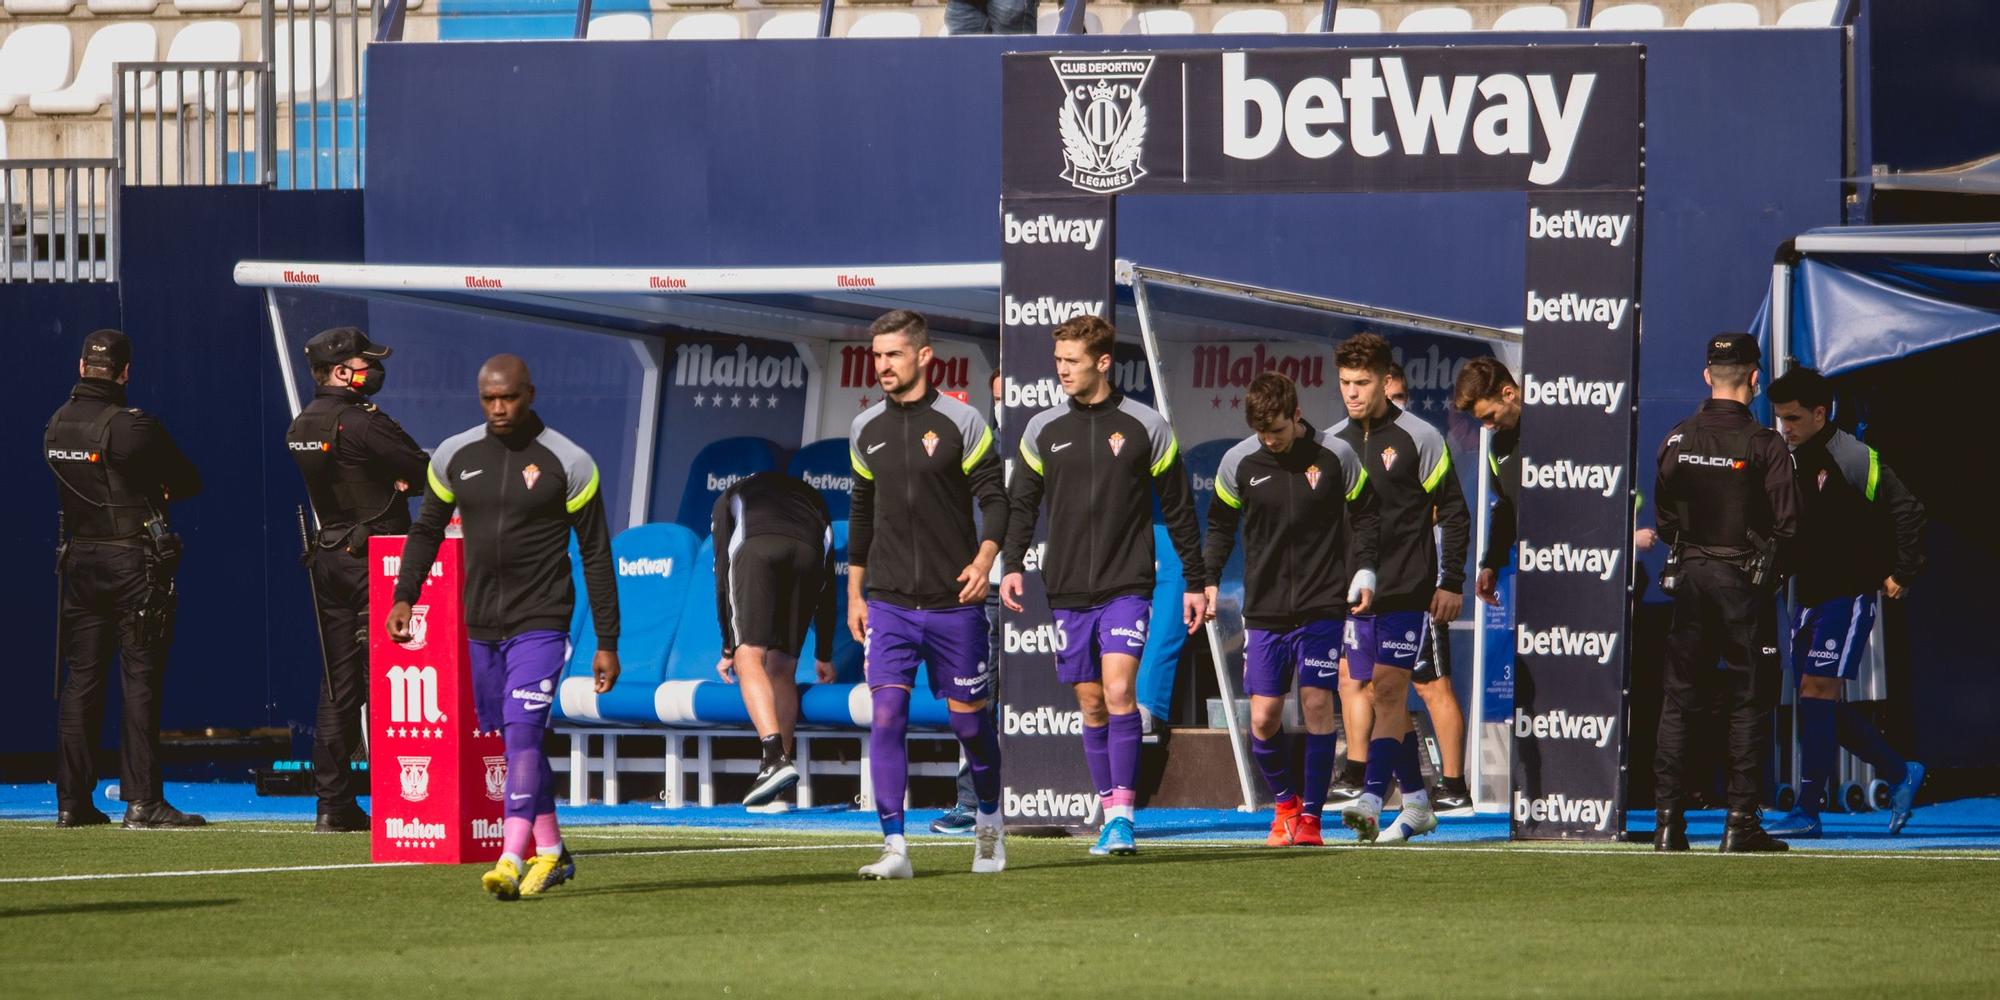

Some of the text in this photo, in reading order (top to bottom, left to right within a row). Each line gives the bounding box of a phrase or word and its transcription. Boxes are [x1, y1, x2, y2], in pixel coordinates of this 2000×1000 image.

[1060, 62, 1145, 74] CLUB DEPORTIVO
[1222, 52, 1597, 186] betway
[1079, 173, 1128, 188] LEGANÉS
[1004, 213, 1104, 251] betway
[1528, 207, 1631, 247] betway
[283, 270, 320, 284] Mahou
[465, 275, 502, 288] Mahou
[649, 276, 687, 288] Mahou
[837, 275, 875, 287] Mahou
[1526, 291, 1628, 330] betway
[674, 342, 804, 388] Mahou
[1004, 376, 1070, 408] betw
[1523, 374, 1625, 414] betway
[48, 449, 91, 461] POLICIA
[288, 440, 325, 451] POLICIA
[1678, 454, 1735, 467] POLICIA
[1521, 457, 1622, 497] betway
[618, 557, 672, 578] betway
[1519, 540, 1620, 581] betway
[1517, 623, 1618, 664] betway
[1503, 665, 1511, 680] 3
[1003, 704, 1084, 735] betwa
[1515, 707, 1615, 748] betway
[1003, 786, 1102, 824] betway
[1513, 790, 1613, 831] betway
[385, 817, 446, 840] Mahou
